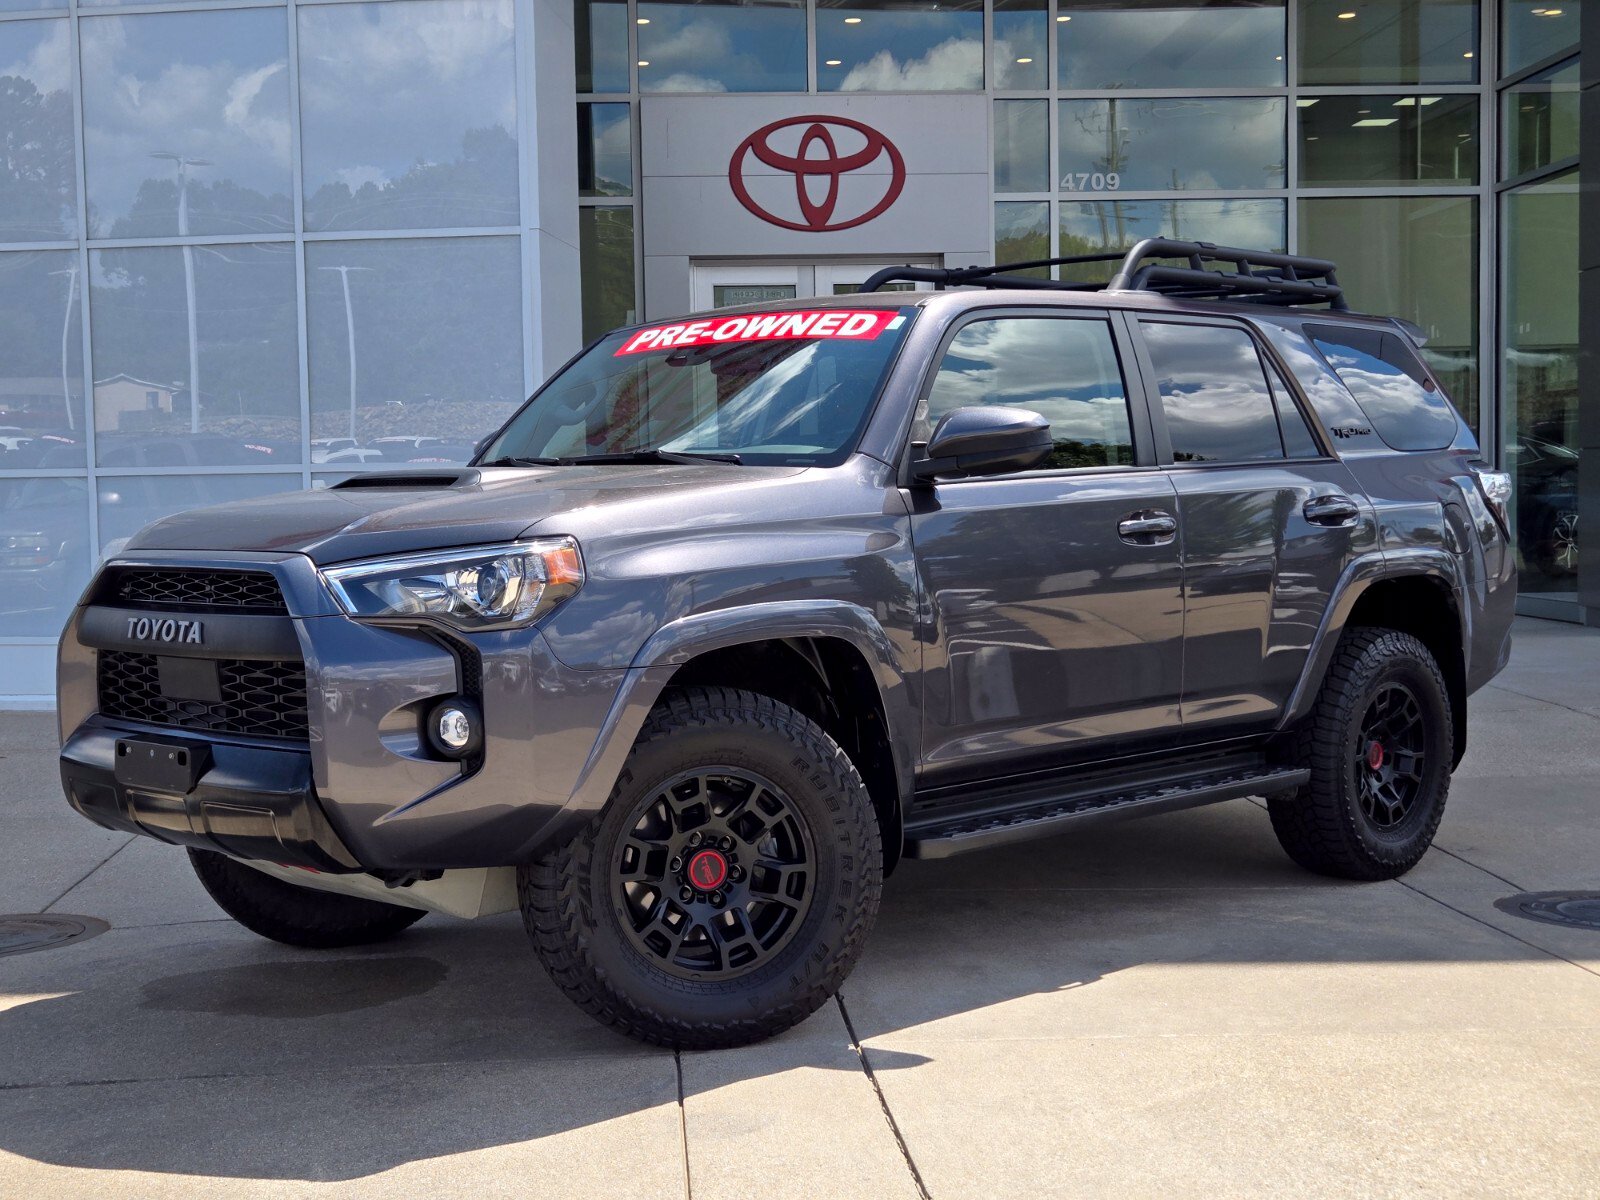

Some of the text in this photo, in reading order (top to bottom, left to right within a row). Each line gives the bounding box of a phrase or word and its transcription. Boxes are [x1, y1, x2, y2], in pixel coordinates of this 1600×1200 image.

[1060, 172, 1120, 191] 4709
[625, 313, 878, 352] PRE-OWNED
[127, 617, 202, 644] TOYOTA
